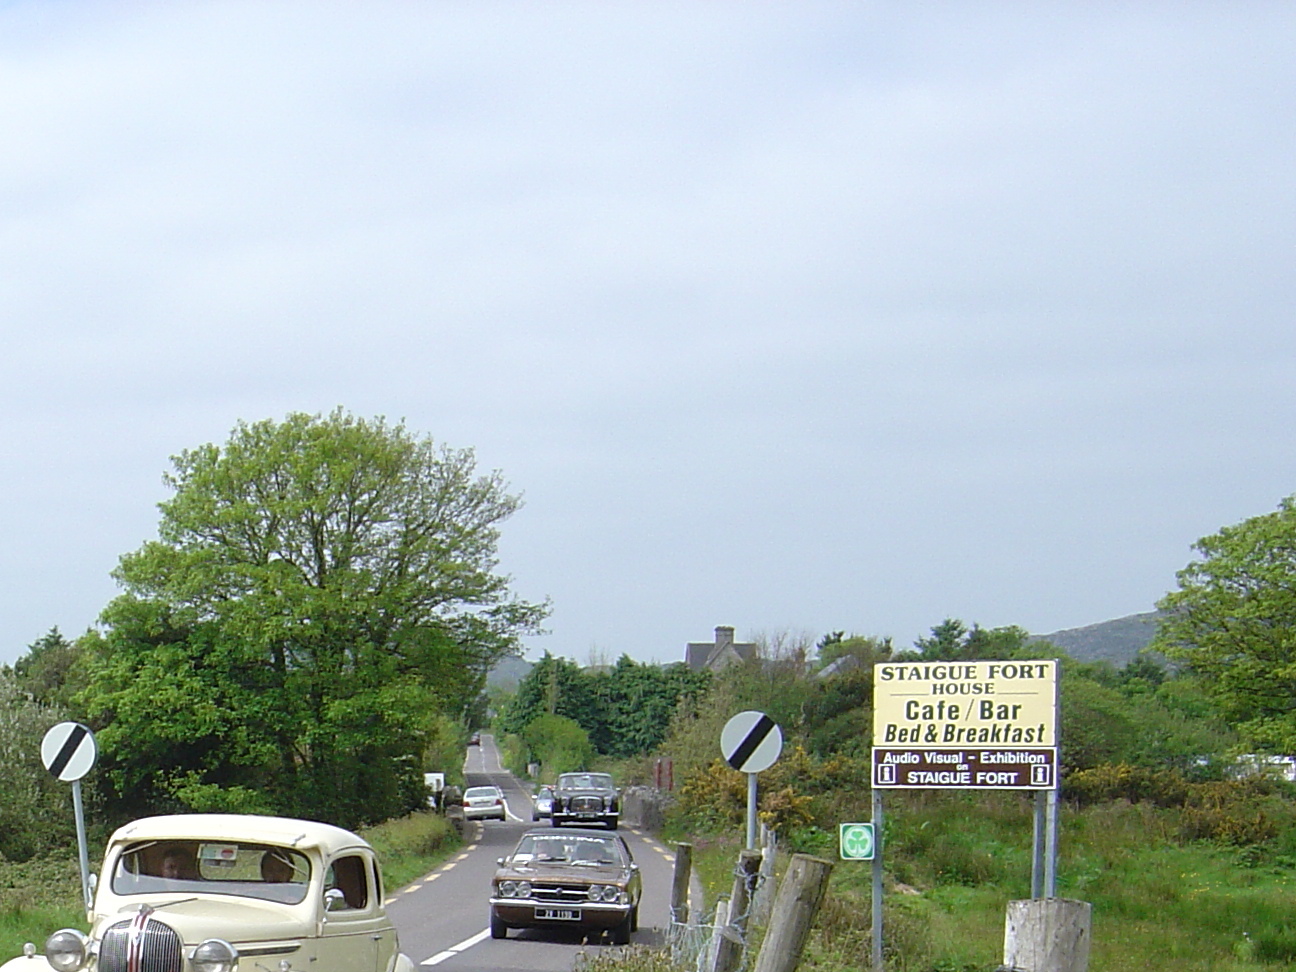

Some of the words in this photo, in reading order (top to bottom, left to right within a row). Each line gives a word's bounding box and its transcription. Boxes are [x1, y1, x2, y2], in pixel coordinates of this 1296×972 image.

[881, 666, 977, 680] STAIGUE
[988, 664, 1049, 679] FORT
[932, 683, 995, 695] HOUSE
[885, 724, 921, 742] Bed
[924, 724, 938, 742] &
[943, 723, 1045, 743] Breakfast
[883, 752, 920, 764] Audio
[924, 752, 963, 764] Visual
[980, 752, 1046, 764] Exhibition
[907, 772, 971, 784] STAIGUE
[976, 772, 1019, 784] FORT
